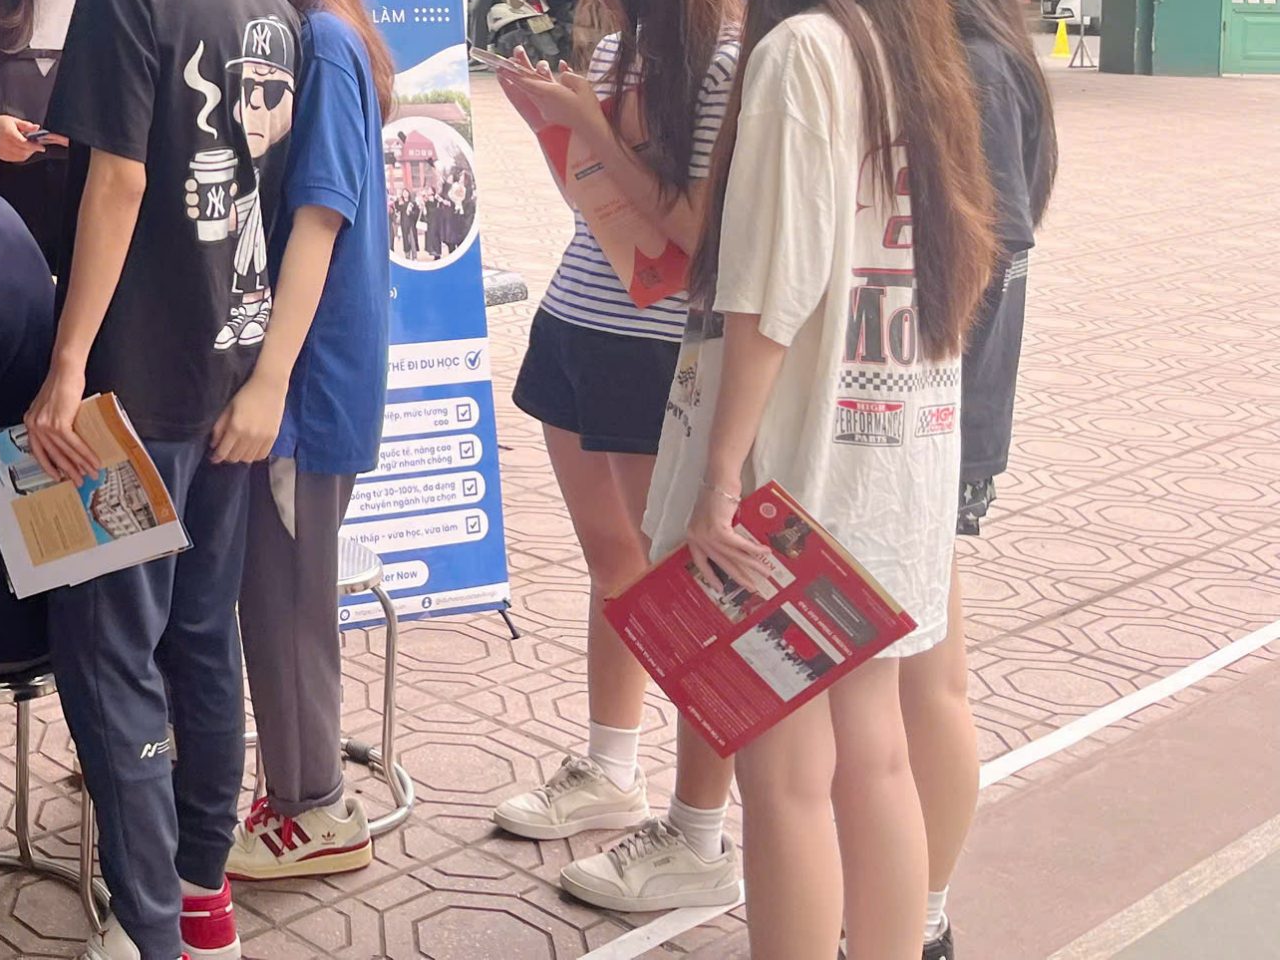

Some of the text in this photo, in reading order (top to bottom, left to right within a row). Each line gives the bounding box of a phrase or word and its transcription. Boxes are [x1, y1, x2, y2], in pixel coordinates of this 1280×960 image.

[373, 6, 405, 24] LÀM
[407, 360, 418, 371] ĐI
[420, 359, 435, 370] DU
[437, 357, 460, 370] HỌC
[434, 418, 449, 426] cao
[436, 444, 452, 452] cao
[399, 458, 426, 468] nhanh
[396, 571, 418, 580] Now
